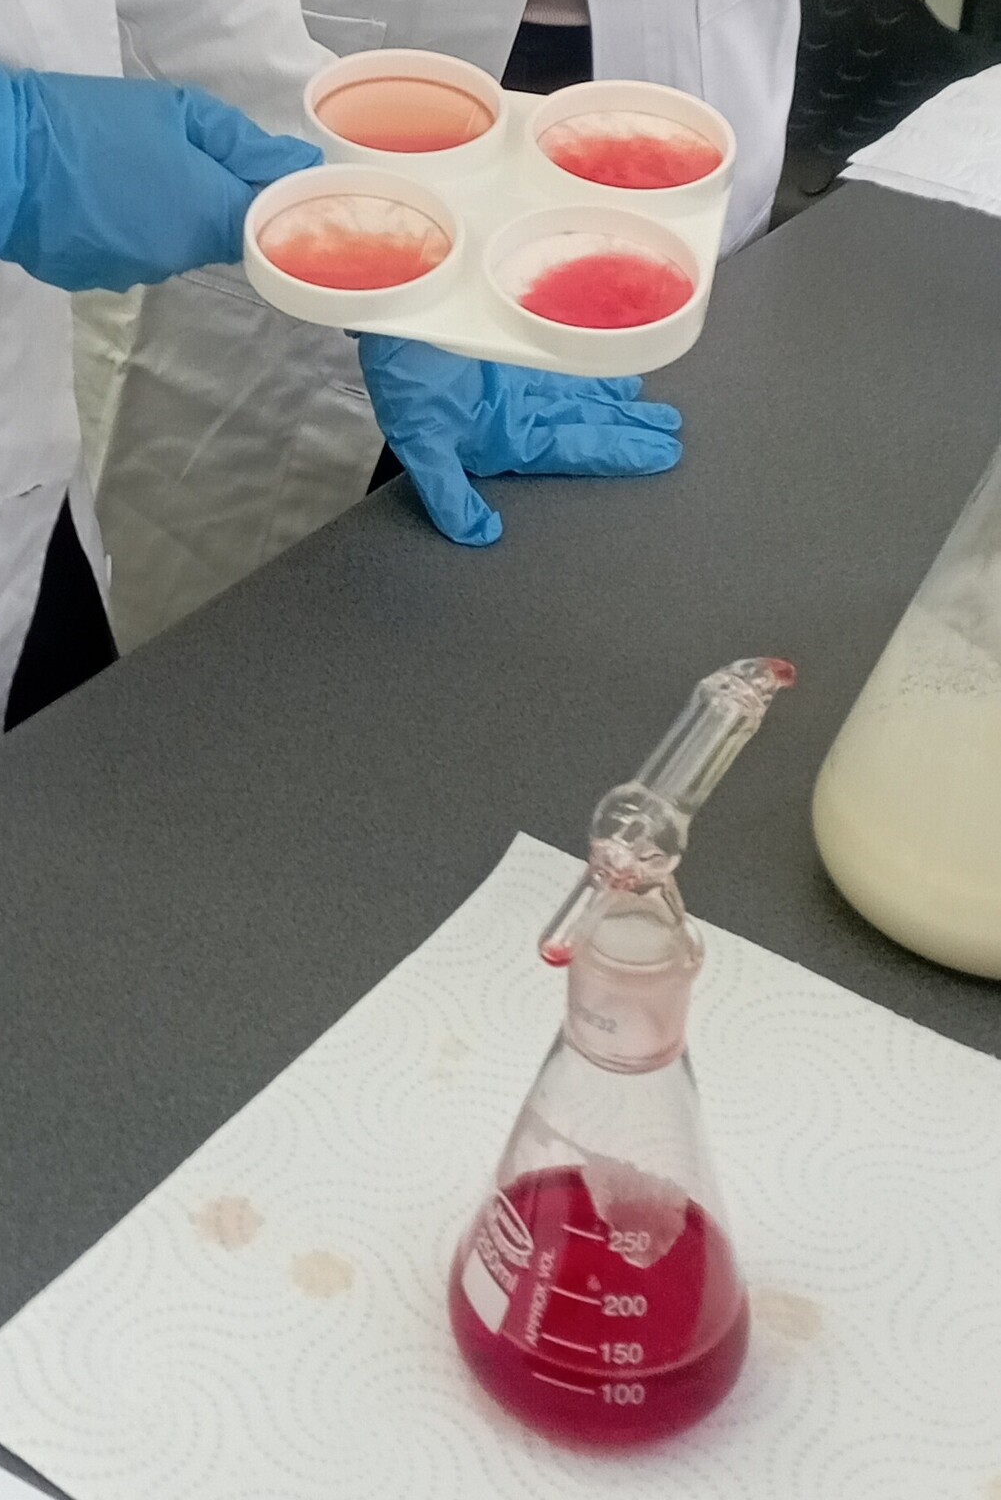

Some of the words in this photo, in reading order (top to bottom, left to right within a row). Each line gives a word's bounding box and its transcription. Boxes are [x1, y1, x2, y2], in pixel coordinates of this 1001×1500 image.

[607, 1230, 651, 1253] 250
[523, 1280, 551, 1348] APPROX
[601, 1294, 648, 1318] 200
[600, 1341, 644, 1365] 150
[600, 1382, 645, 1406] 100
